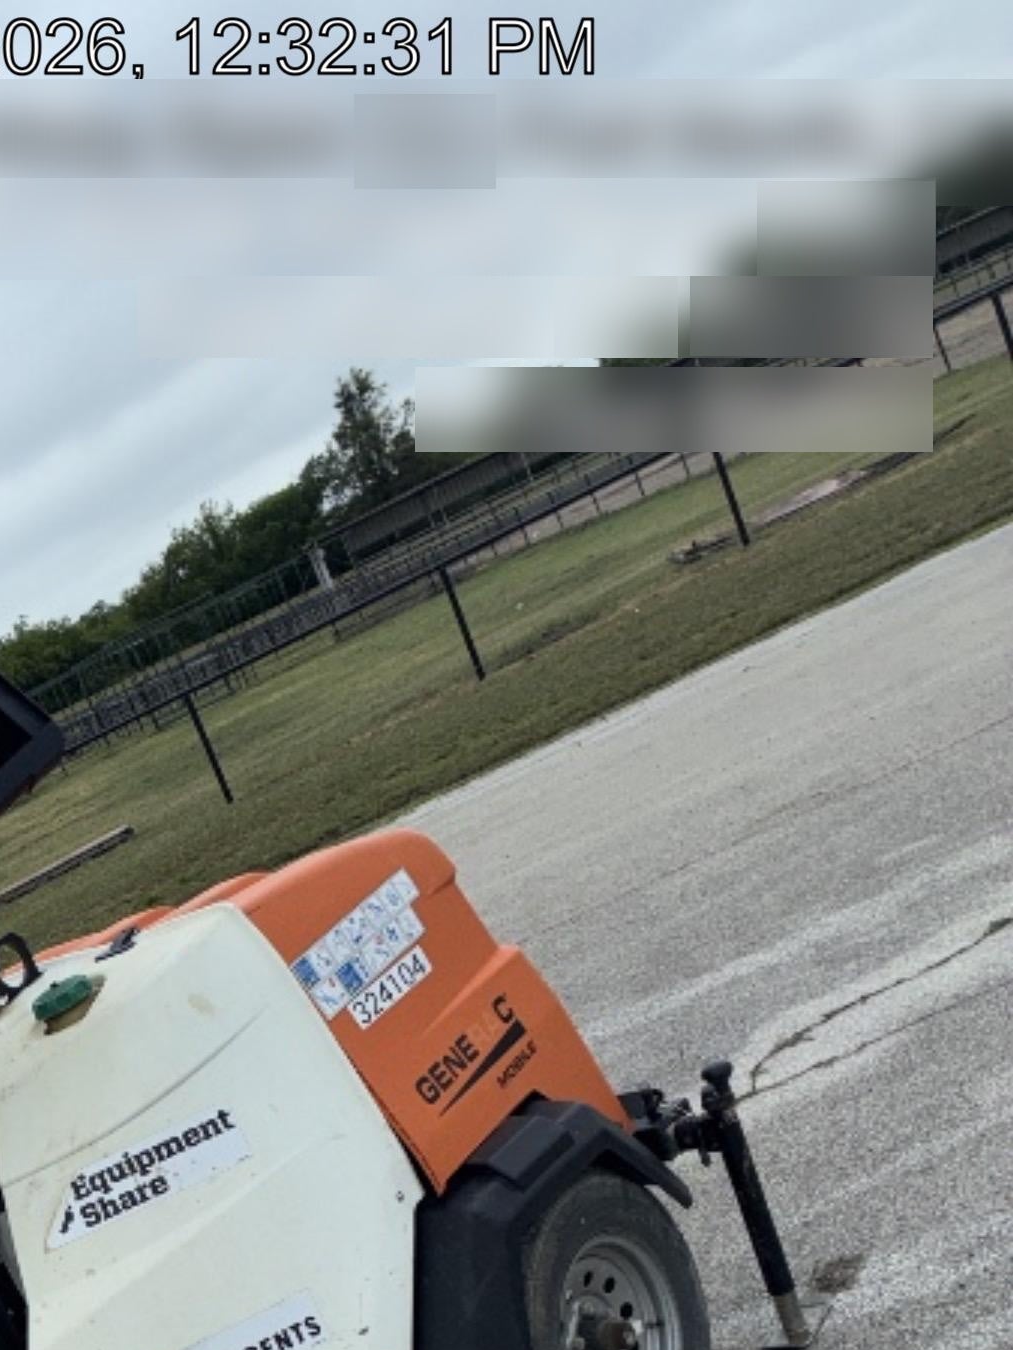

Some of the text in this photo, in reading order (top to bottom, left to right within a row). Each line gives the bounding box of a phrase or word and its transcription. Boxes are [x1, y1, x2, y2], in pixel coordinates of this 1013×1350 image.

[352, 955, 426, 1025] 324104
[415, 993, 513, 1104] GENEC
[70, 1109, 236, 1201] Equipment
[79, 1175, 169, 1228] Share
